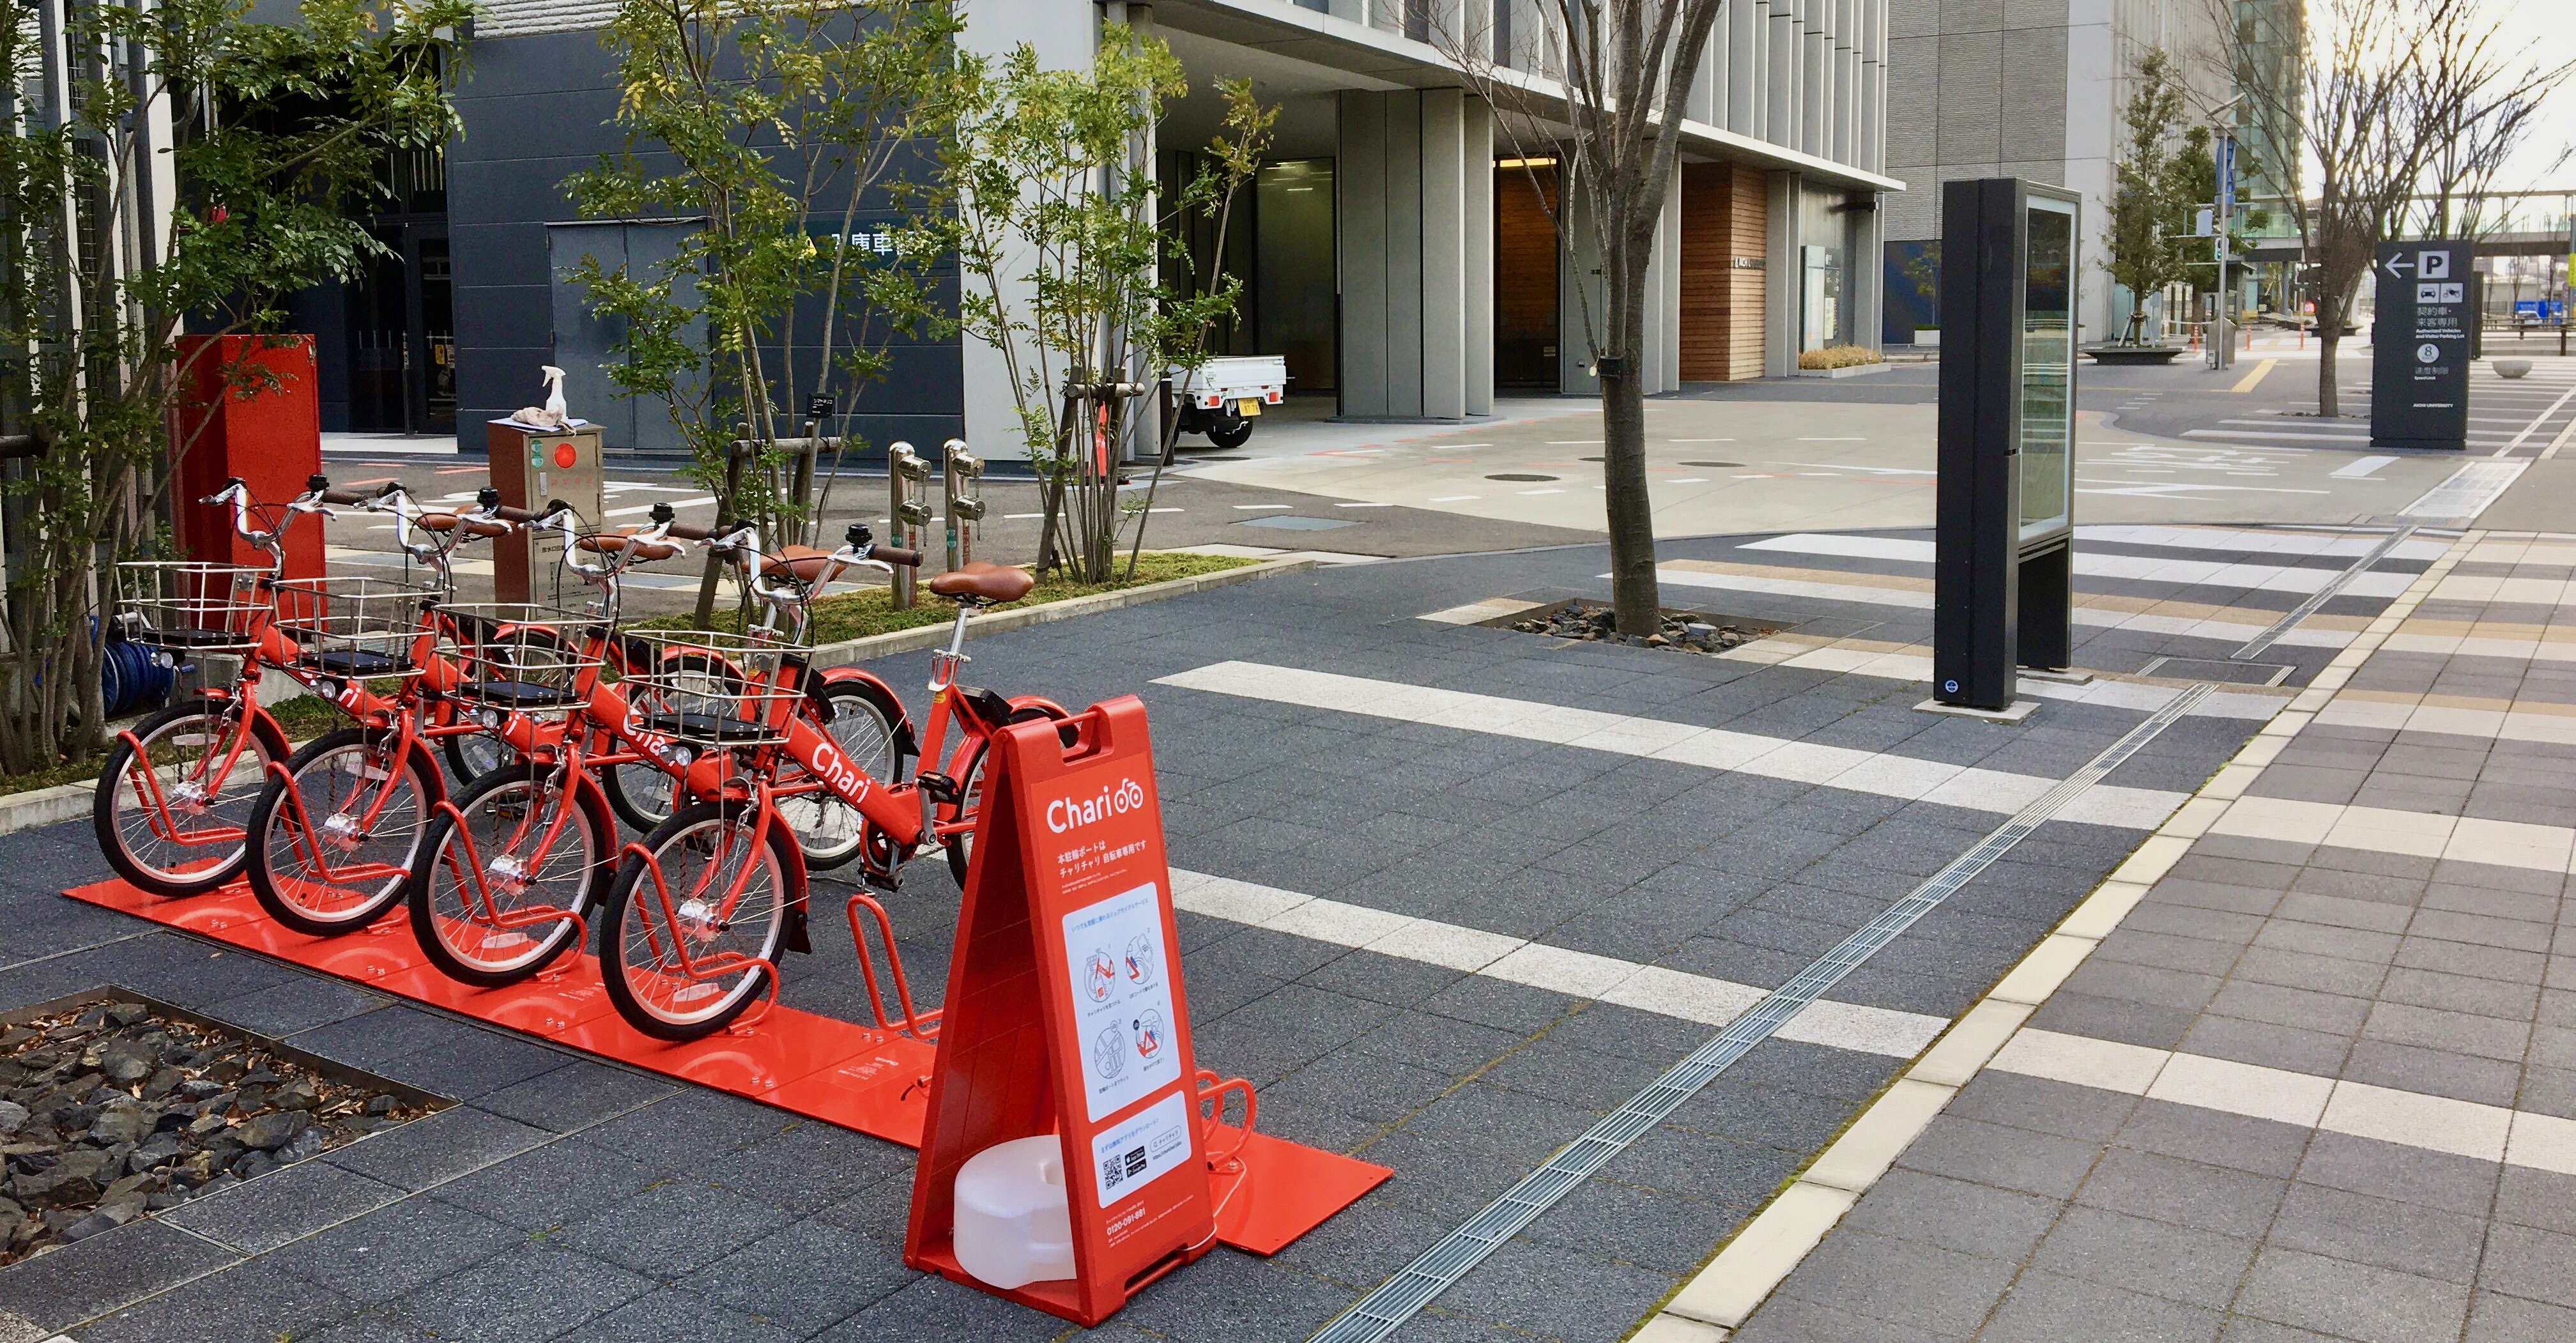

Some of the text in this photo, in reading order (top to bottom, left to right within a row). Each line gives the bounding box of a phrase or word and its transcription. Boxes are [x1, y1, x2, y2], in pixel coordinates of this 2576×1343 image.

[2426, 256, 2442, 274] P
[2425, 346, 2432, 357] 8
[812, 742, 872, 805] Chari
[1046, 785, 1113, 834] Chari
[1057, 840, 1107, 865] 本駐輪ポートは
[1059, 839, 1147, 879] チャリチャリ 自転車専用です
[1107, 1207, 1146, 1236] 0120-091-881
